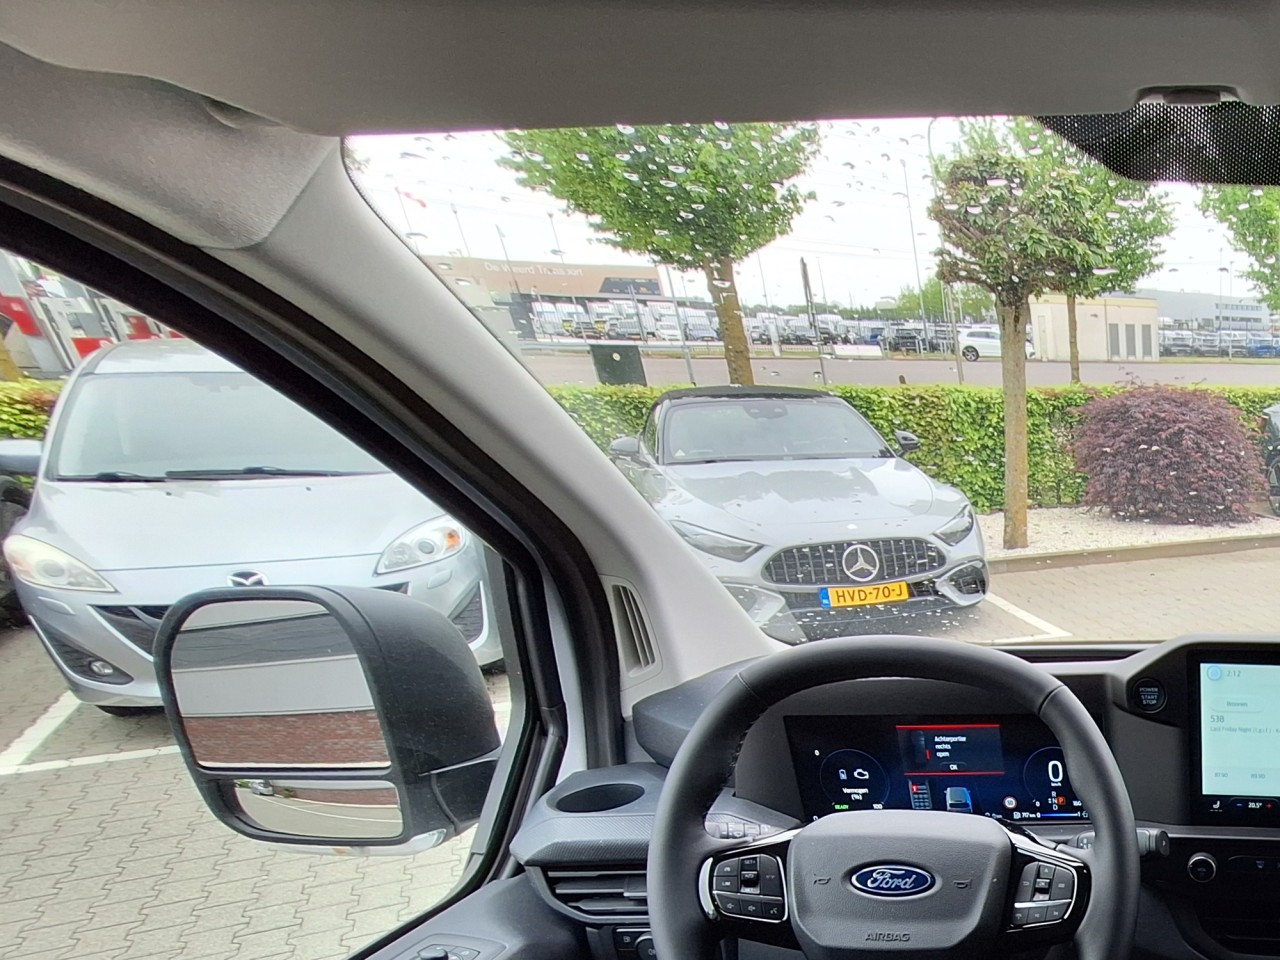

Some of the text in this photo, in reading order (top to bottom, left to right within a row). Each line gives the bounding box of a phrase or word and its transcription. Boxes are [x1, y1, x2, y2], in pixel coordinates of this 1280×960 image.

[835, 584, 903, 605] HVD-70-J
[1048, 760, 1063, 782] 0
[867, 869, 917, 889] Ford
[865, 932, 910, 942] AIRBAG
